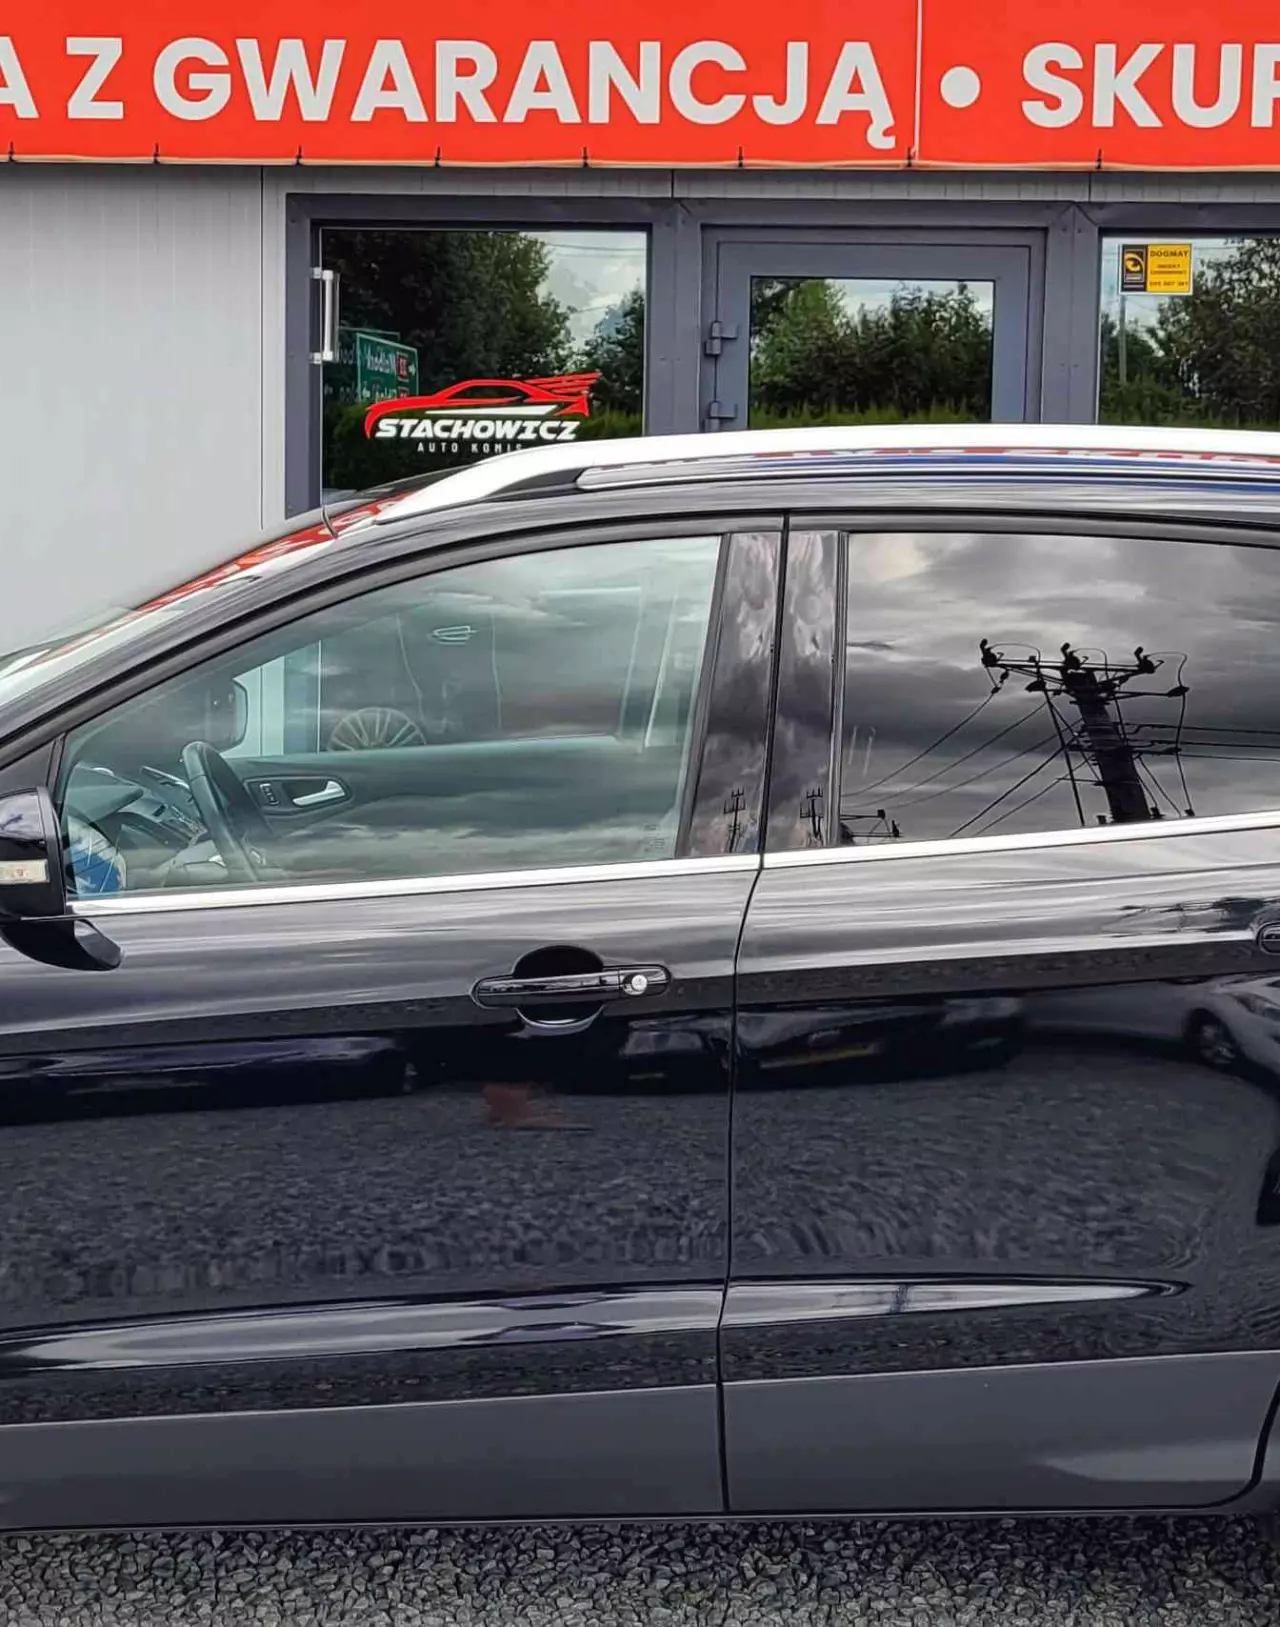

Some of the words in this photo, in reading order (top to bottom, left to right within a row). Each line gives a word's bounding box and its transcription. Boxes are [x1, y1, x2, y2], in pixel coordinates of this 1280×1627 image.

[67, 38, 123, 119] Z
[154, 38, 895, 149] GWARANCJĄ
[375, 419, 581, 440] STACHOWICZ
[417, 442, 458, 453] AUTO
[471, 442, 522, 453] KOMIS
